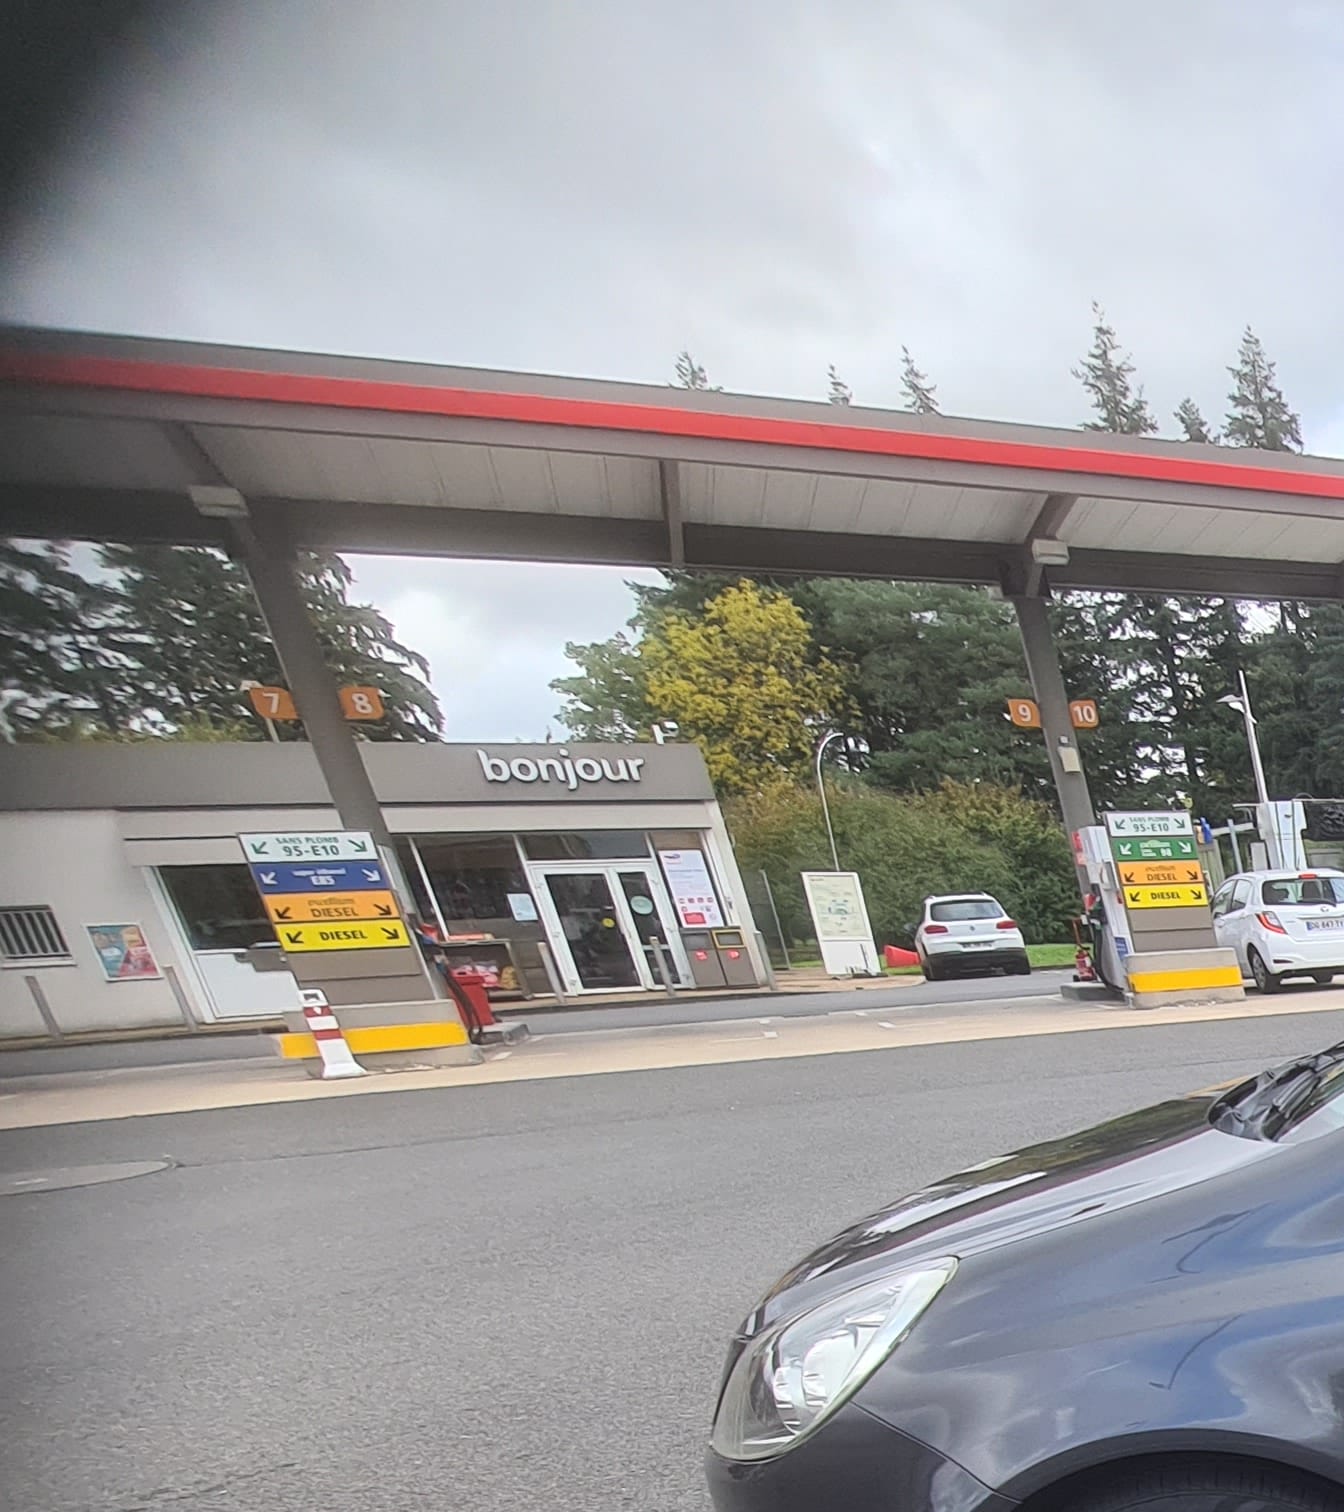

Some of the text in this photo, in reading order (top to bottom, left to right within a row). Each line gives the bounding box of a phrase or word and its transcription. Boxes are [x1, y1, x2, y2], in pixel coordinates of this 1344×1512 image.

[262, 692, 279, 714] 7
[351, 692, 373, 714] 8
[1018, 703, 1032, 722] 9
[1073, 705, 1096, 723] 10
[476, 748, 645, 791] bonjour
[1133, 823, 1169, 833] 95-E10
[283, 844, 339, 857] 95-E10
[1146, 872, 1178, 881] DIESEL
[1150, 891, 1182, 900] DIESEL
[310, 907, 359, 917] DIESEL
[319, 930, 368, 941] DIESEL
